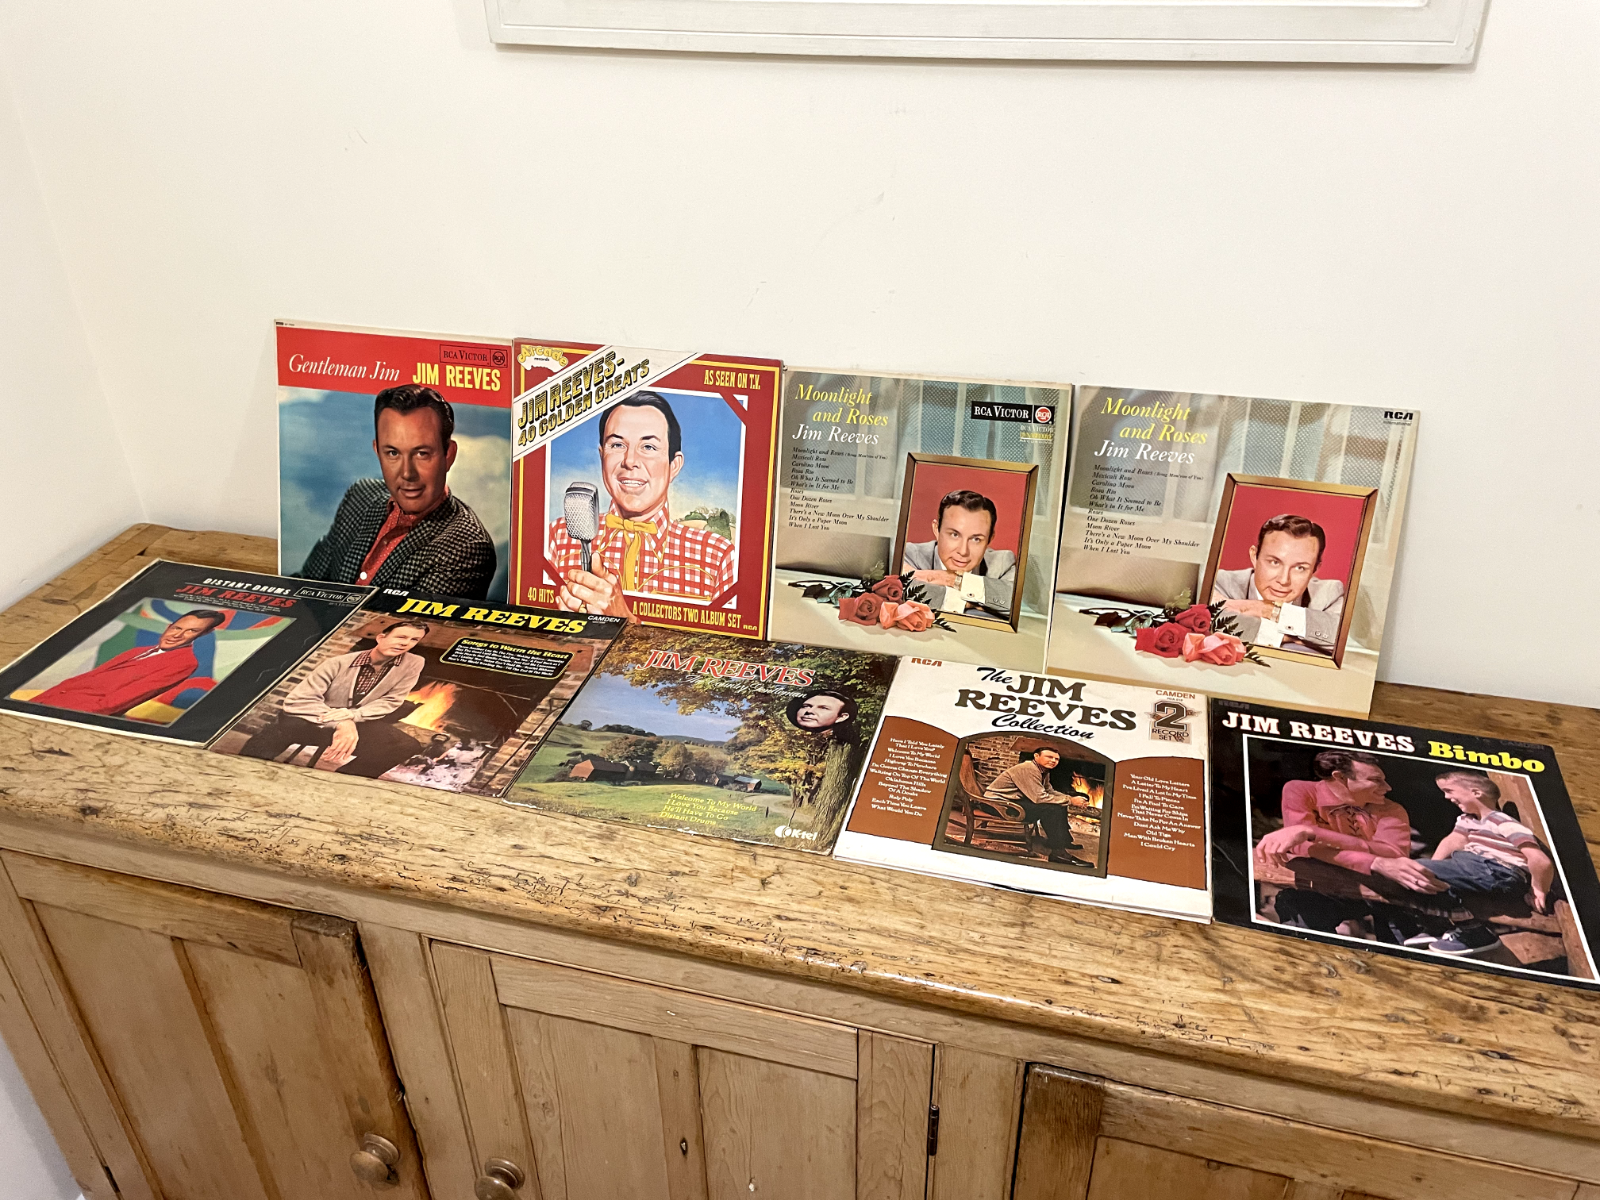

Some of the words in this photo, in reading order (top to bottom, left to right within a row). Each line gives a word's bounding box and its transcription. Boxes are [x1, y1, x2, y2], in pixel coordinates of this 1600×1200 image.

[443, 351, 458, 360] RCA
[459, 350, 488, 361] VICTOR
[517, 345, 568, 367] Arcade
[288, 354, 366, 378] Gentleman
[370, 360, 400, 382] Jim
[412, 362, 439, 386] JIM
[446, 365, 501, 392] REEVES
[704, 370, 714, 386] AS
[717, 371, 735, 387] SEEN
[737, 372, 748, 389] ON
[518, 390, 548, 428] JIM
[550, 351, 624, 412] REEVES-
[795, 384, 872, 407] Moonlight
[518, 425, 536, 446] 40
[538, 391, 592, 436] GOLDEN
[595, 358, 650, 404] GREATS
[1101, 397, 1190, 422] Moonlight
[813, 408, 843, 422] and
[846, 408, 888, 426] Roses
[974, 406, 992, 416] RCA
[993, 405, 1029, 419] VICTOR
[1384, 411, 1413, 420] RCA
[792, 424, 821, 440] Jim
[828, 426, 879, 444] Reeves
[1120, 423, 1155, 439] and
[1158, 424, 1208, 444] Roses
[1094, 440, 1129, 458] Jim
[1135, 442, 1195, 464] Reeves
[1094, 465, 1122, 473] Moonlight
[1092, 479, 1116, 487] Carolina
[1100, 494, 1115, 502] What
[1096, 538, 1109, 546] Only
[1174, 539, 1200, 547] Shoulder
[203, 578, 252, 589] DISTANT
[252, 584, 291, 595] DRUMS
[316, 591, 344, 600] VICTOR
[383, 588, 409, 597] RCA
[528, 587, 537, 601] 40
[539, 588, 554, 603] HITS
[176, 585, 218, 596] JIM
[218, 590, 297, 608] REEVES
[396, 598, 460, 618] JIM
[461, 606, 587, 634] REEVES
[632, 602, 638, 615] A
[639, 604, 682, 620] COLLECTORS
[683, 608, 698, 623] TWO
[701, 610, 725, 626] ALBUM
[728, 614, 742, 628] SET
[461, 639, 488, 648] Songs
[500, 645, 526, 653] Warm
[543, 651, 569, 659] Heart
[636, 650, 699, 671] JIM
[701, 656, 815, 686] REEVES
[911, 657, 942, 667] RCA
[976, 666, 1013, 684] The
[1006, 674, 1086, 702] JIM
[1156, 690, 1196, 699] CAMDEN
[954, 688, 1138, 731] REEVES
[1154, 700, 1187, 731] 2
[991, 713, 1095, 739] Collection
[1152, 728, 1190, 737] RECORD
[1222, 711, 1280, 735] JIM
[1290, 721, 1416, 753] REEVES
[1427, 741, 1545, 773] Bimbo
[670, 793, 704, 803] Welcome
[733, 803, 757, 812] World
[682, 808, 703, 816] Have
[708, 806, 738, 815] Because
[660, 812, 688, 821] Distant
[689, 816, 717, 825] Drums
[792, 828, 818, 841] K-tel
